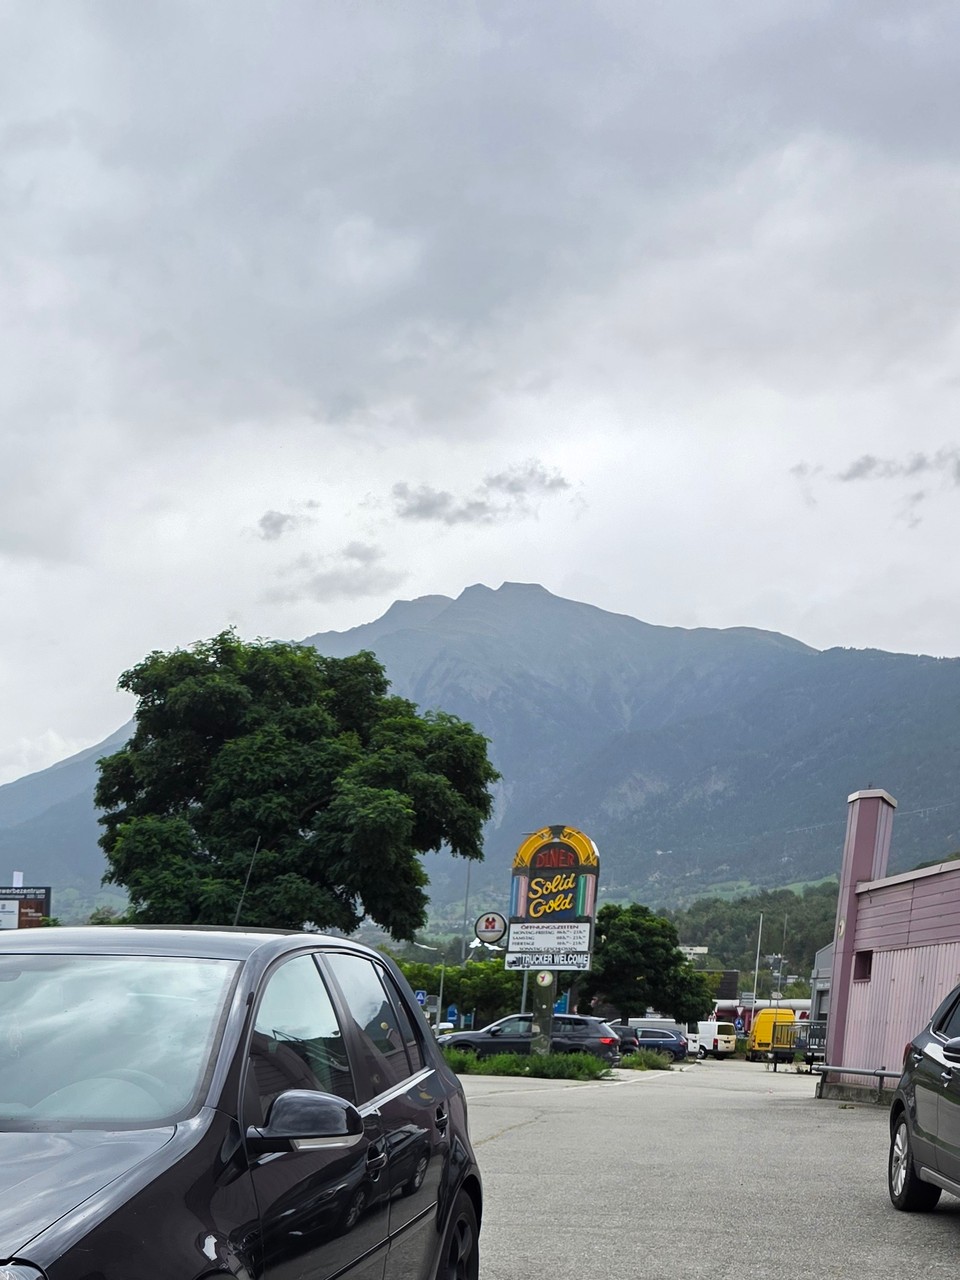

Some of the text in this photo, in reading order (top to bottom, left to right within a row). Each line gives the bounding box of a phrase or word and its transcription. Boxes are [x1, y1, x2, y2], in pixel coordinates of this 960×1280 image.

[536, 848, 575, 867] DINER
[528, 873, 576, 899] Solid
[529, 893, 573, 918] Gold
[522, 954, 589, 964] TRUCKER WELCOME
